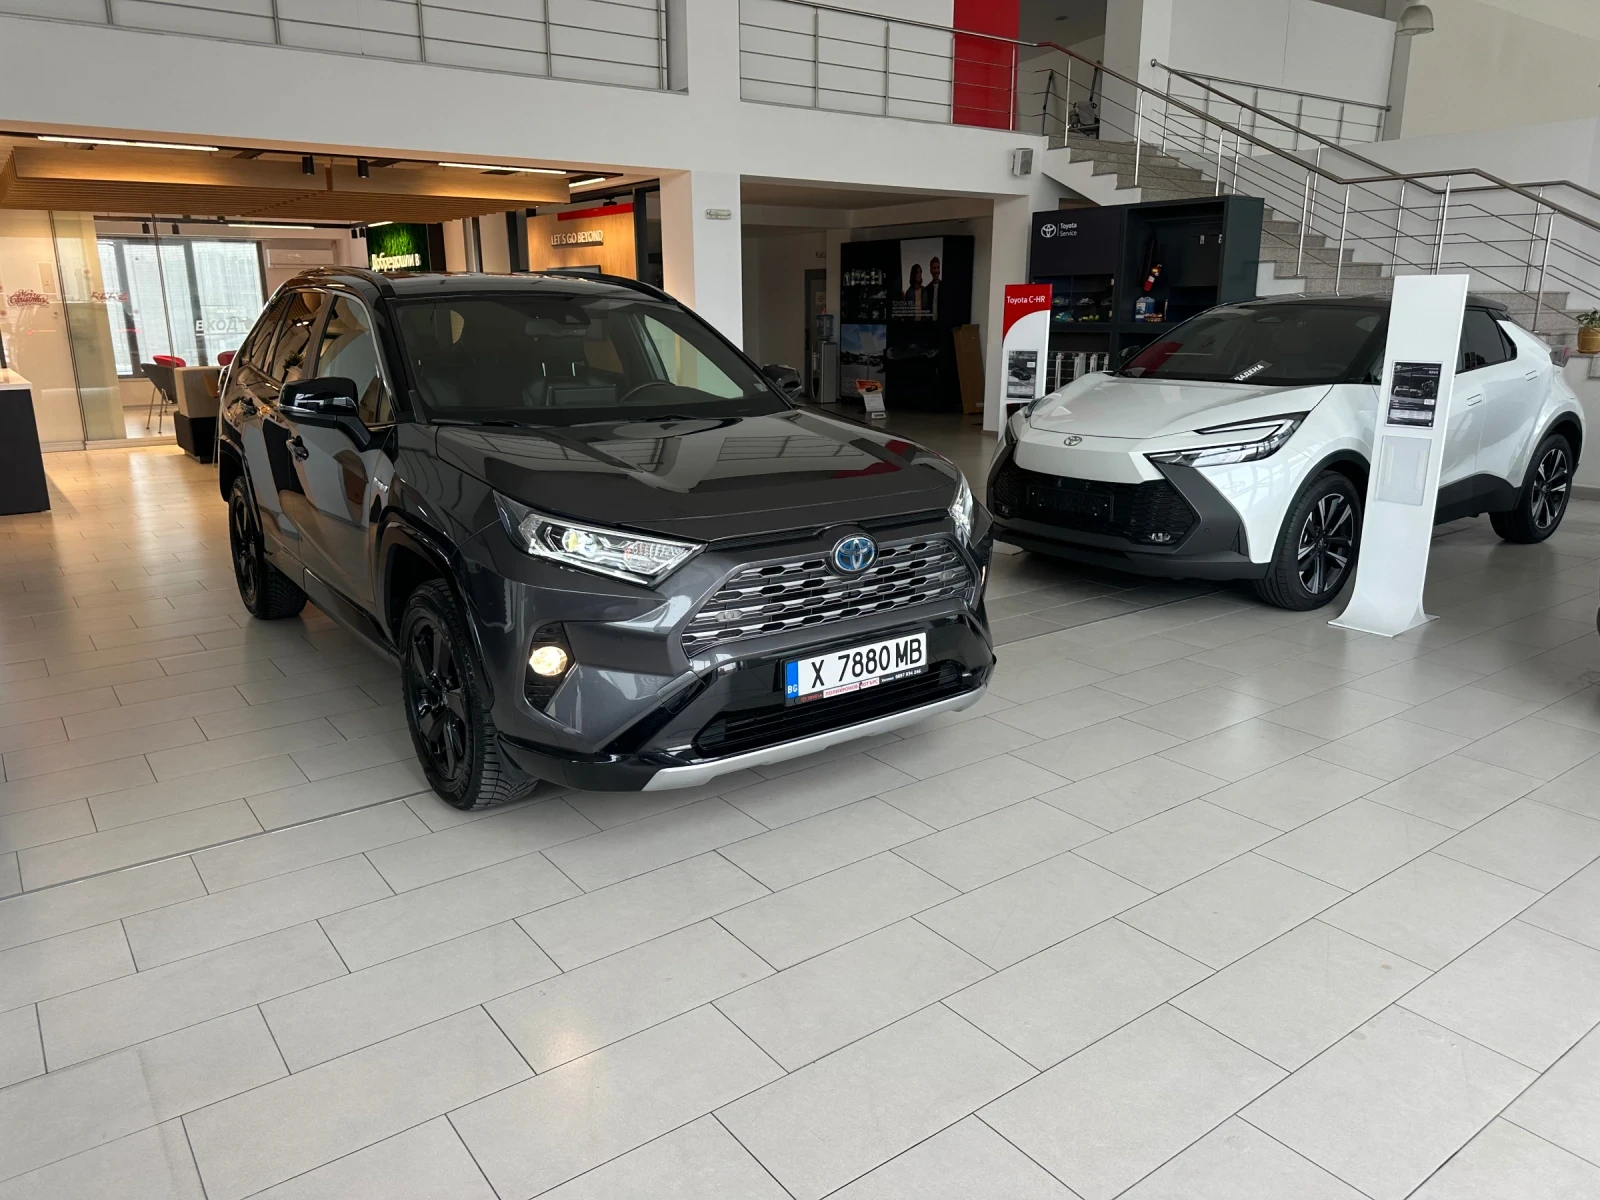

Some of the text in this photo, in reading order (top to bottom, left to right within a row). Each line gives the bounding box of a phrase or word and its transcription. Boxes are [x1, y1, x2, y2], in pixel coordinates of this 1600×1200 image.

[567, 232, 577, 244] GO
[577, 230, 604, 243] BEYOND
[8, 293, 50, 306] Christmas
[16, 289, 40, 299] Merry
[1006, 295, 1046, 305] Toyota C-HR
[811, 638, 922, 689] X 7880 MB
[787, 683, 798, 694] BG
